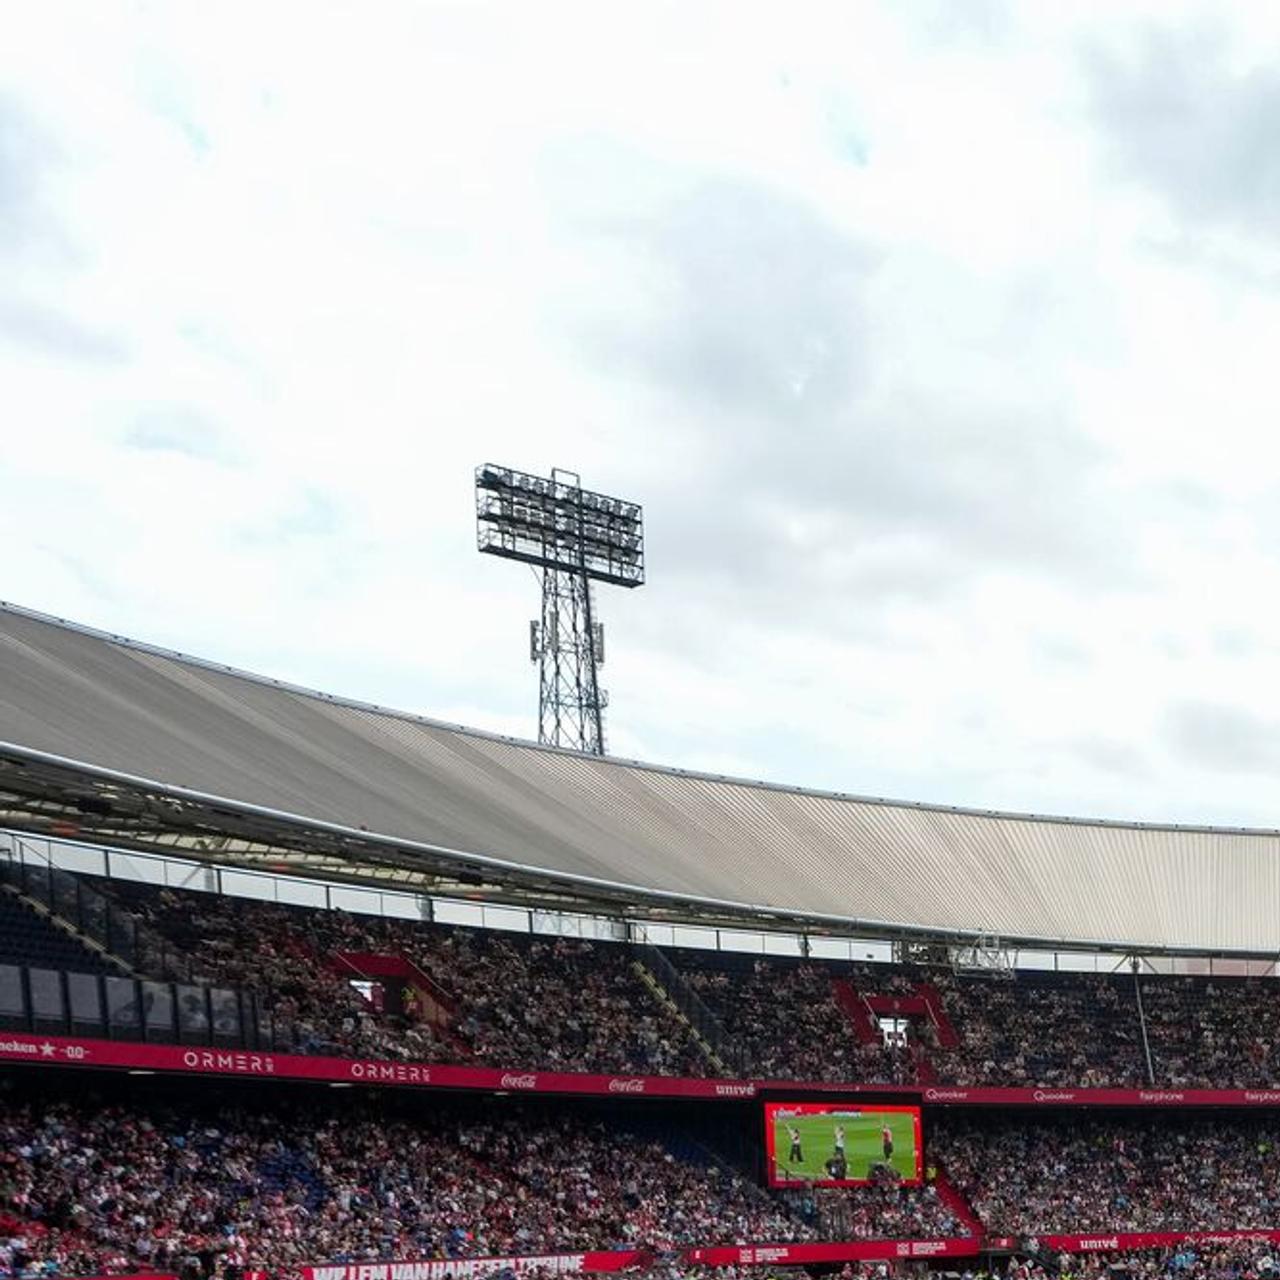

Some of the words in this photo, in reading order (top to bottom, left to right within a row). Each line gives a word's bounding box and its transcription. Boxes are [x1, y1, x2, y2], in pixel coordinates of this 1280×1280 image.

[183, 1052, 262, 1072] ORMER
[352, 1063, 424, 1081] ORMER
[716, 1083, 756, 1096] univé
[1139, 1091, 1184, 1102] fairphone
[1080, 1236, 1119, 1250] univé
